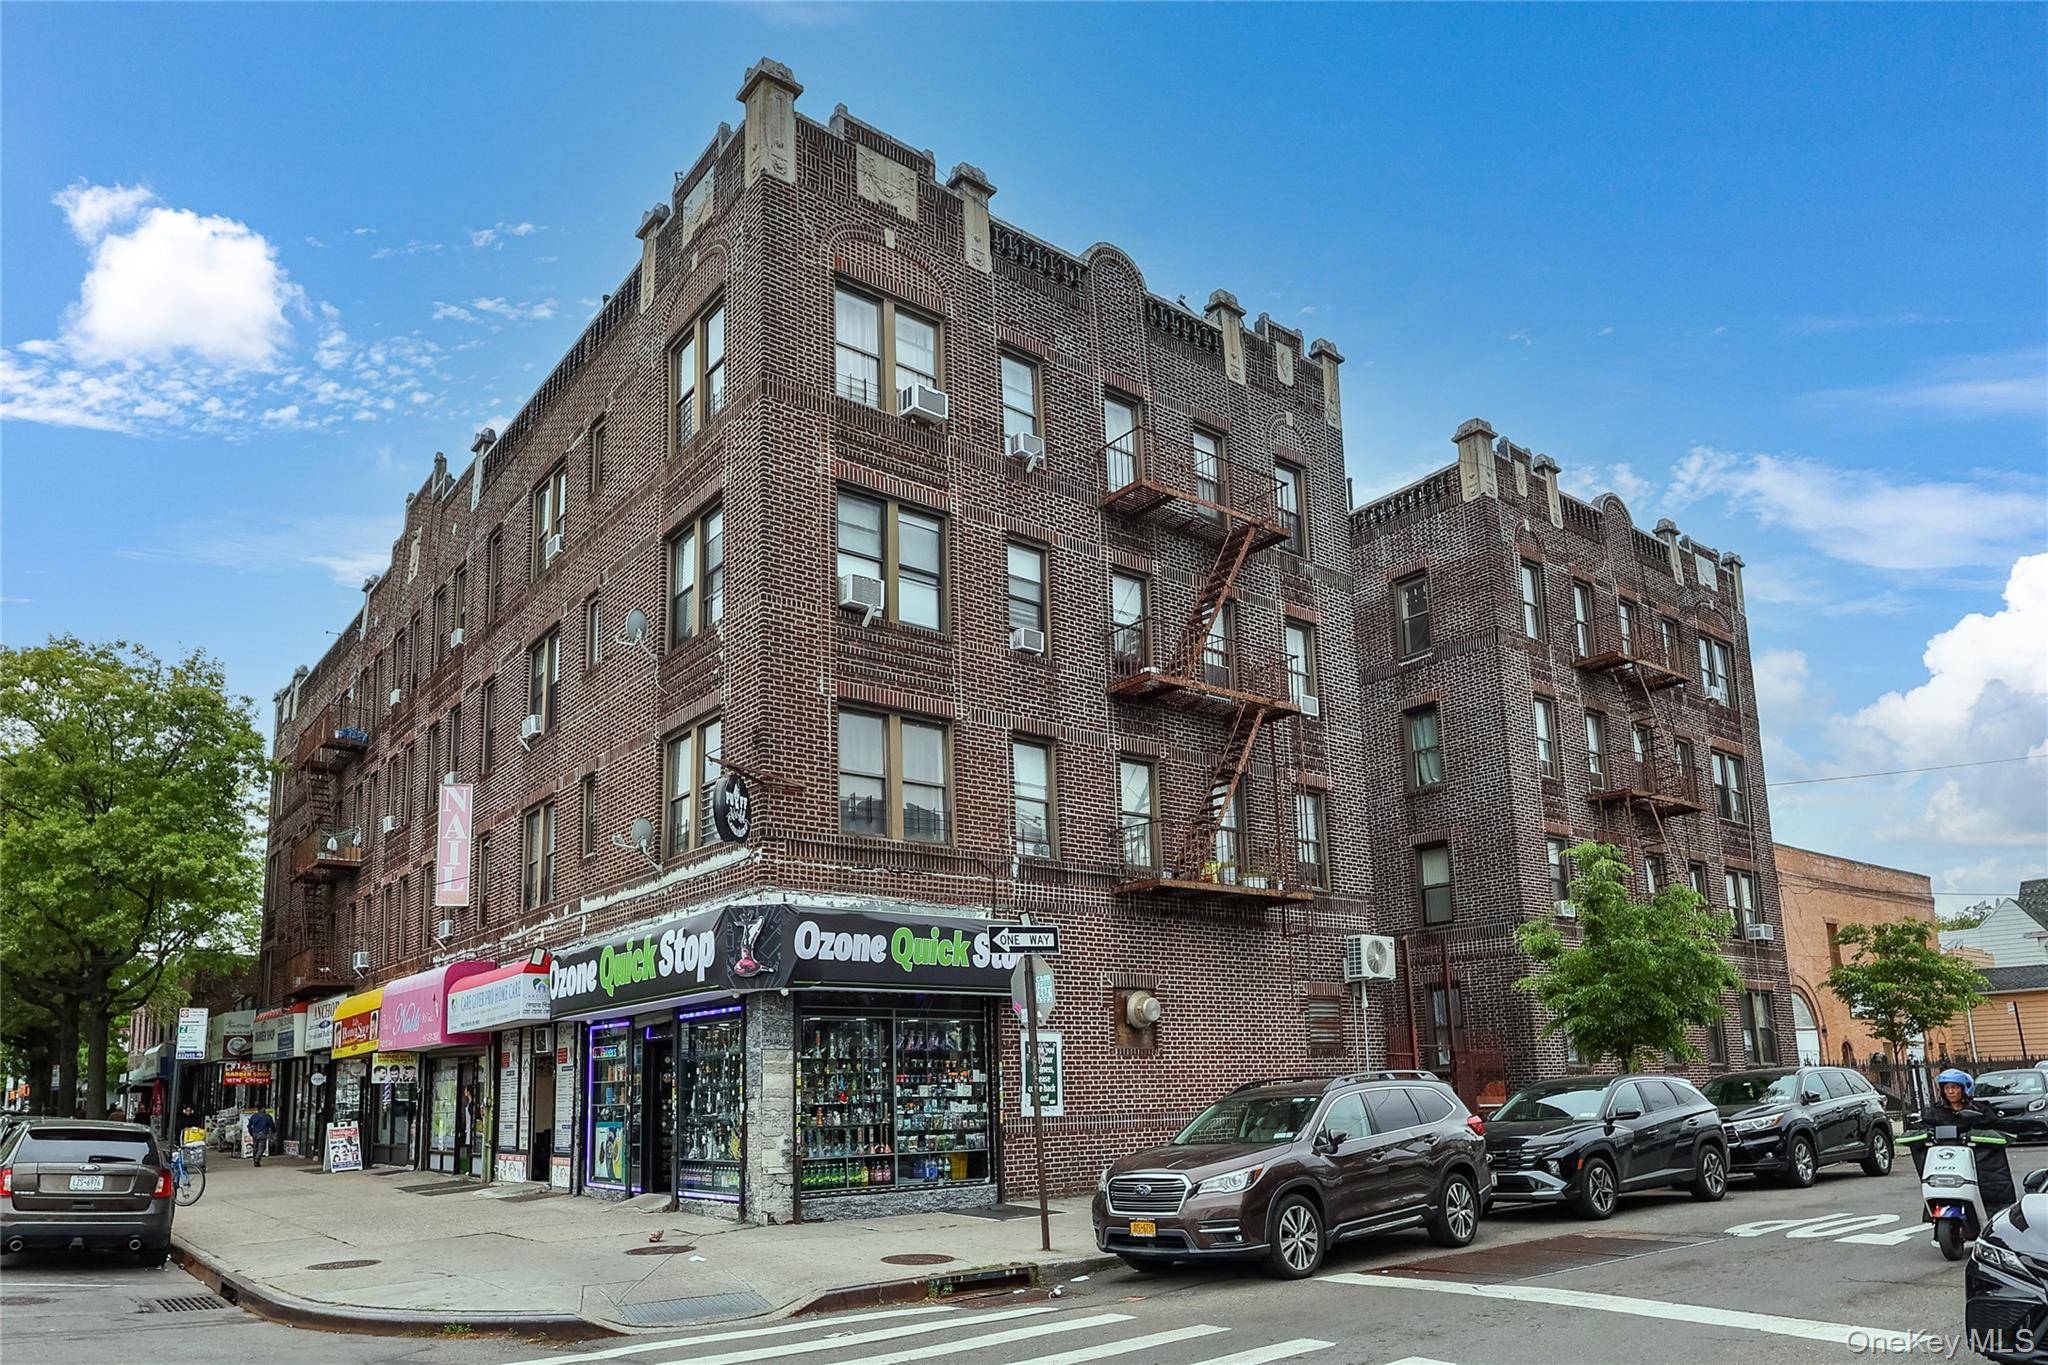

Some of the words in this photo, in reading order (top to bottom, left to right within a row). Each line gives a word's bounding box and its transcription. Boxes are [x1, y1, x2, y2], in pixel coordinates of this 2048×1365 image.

[442, 786, 469, 892] NAIL
[550, 959, 598, 1000] Ozone
[599, 934, 659, 998] Quick
[658, 928, 715, 983] Stop
[794, 920, 887, 962] Ozone
[891, 926, 972, 973] Quick
[1000, 934, 1021, 945] ONE
[1029, 934, 1050, 945] WAY
